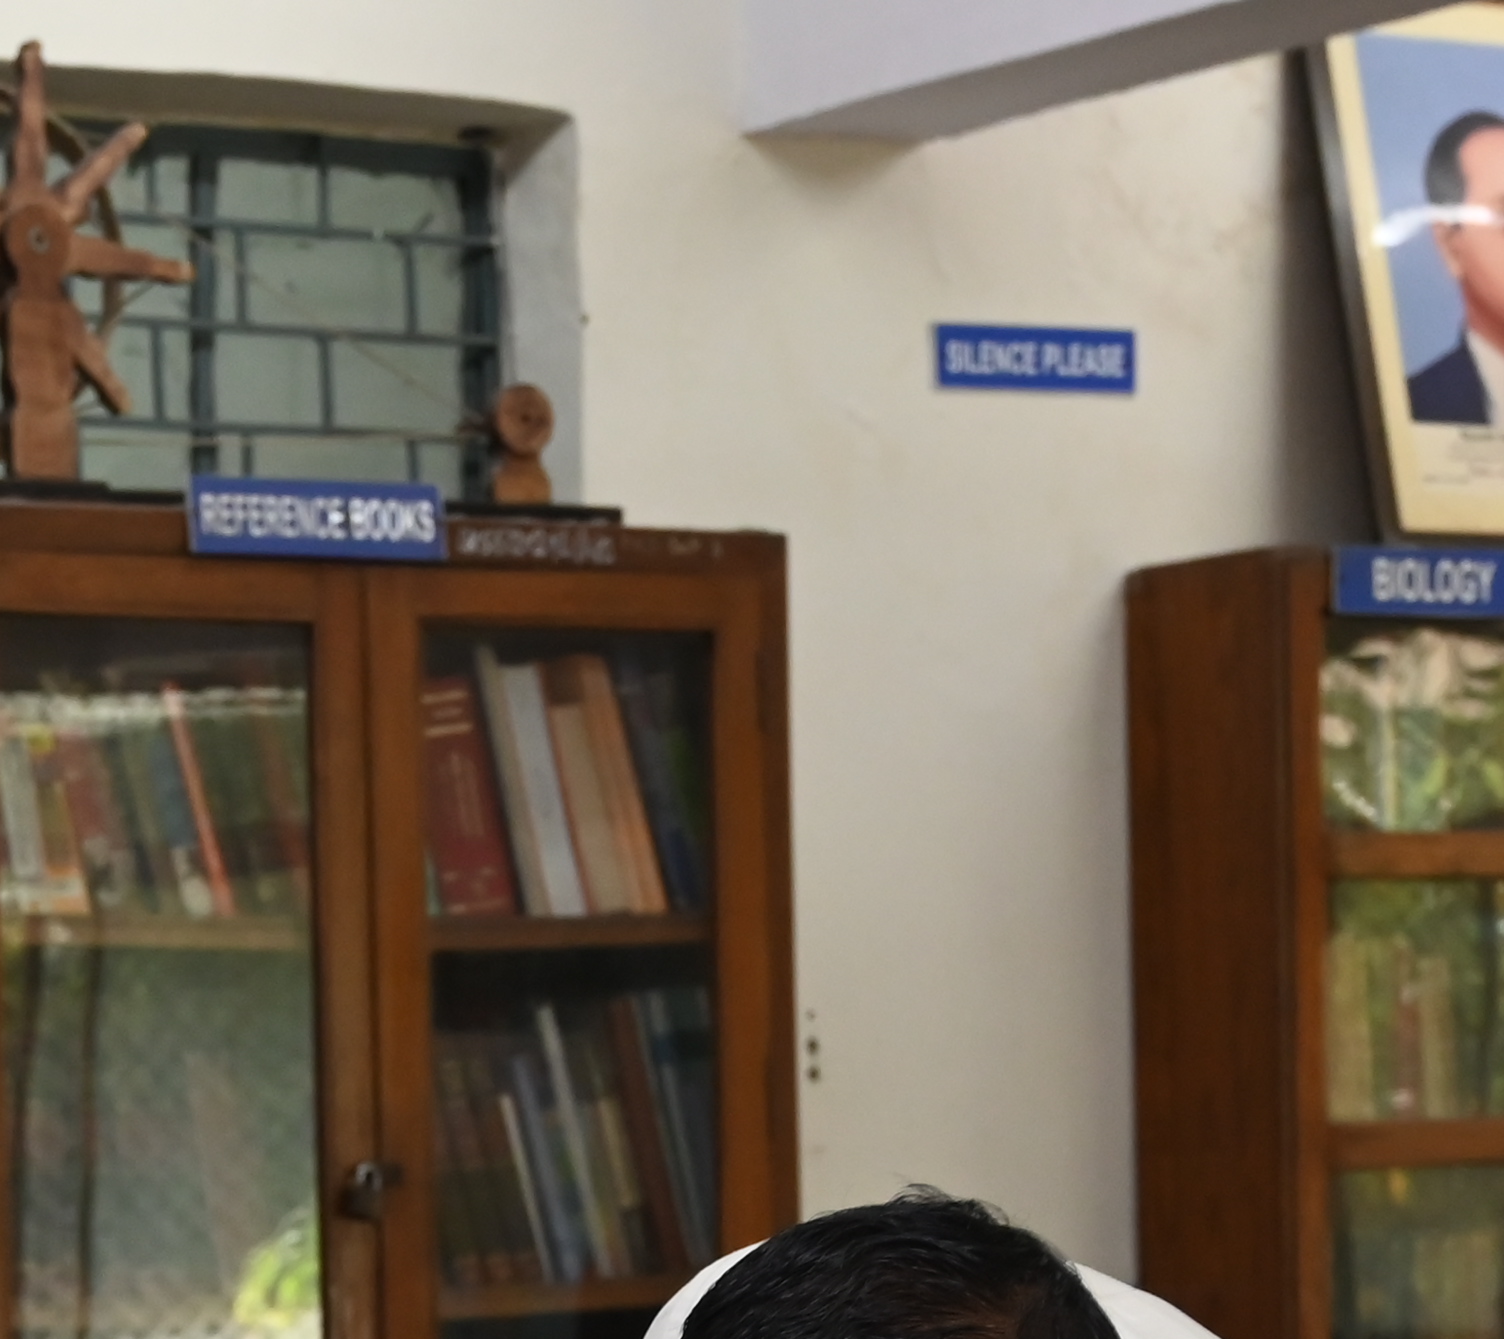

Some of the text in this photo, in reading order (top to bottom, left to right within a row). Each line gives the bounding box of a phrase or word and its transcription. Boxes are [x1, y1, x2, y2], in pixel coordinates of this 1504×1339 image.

[946, 340, 1124, 377] SILENCE PLEASE
[200, 493, 435, 542] REFERENCE BOOKS
[1373, 557, 1495, 603] BIOLOGY
